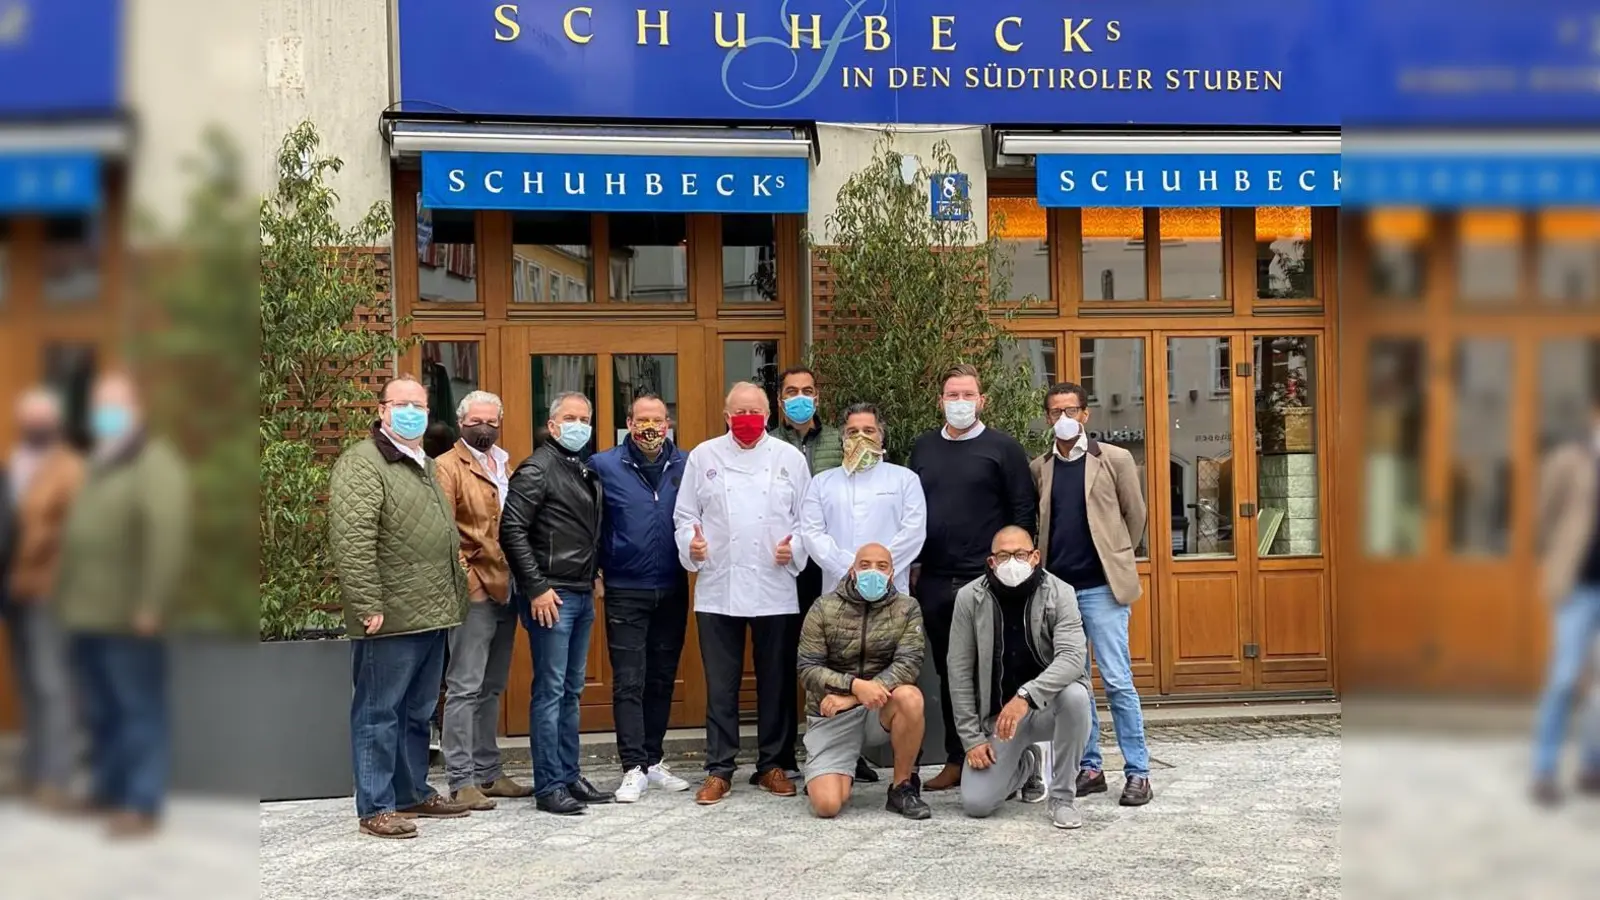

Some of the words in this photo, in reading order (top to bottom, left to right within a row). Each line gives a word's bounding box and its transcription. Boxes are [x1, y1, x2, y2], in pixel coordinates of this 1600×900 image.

[841, 66, 874, 88] IN
[888, 66, 951, 90] DEN
[965, 63, 1154, 91] SÜDTIROLER
[1166, 69, 1283, 92] STUBEN
[943, 176, 956, 198] 8
